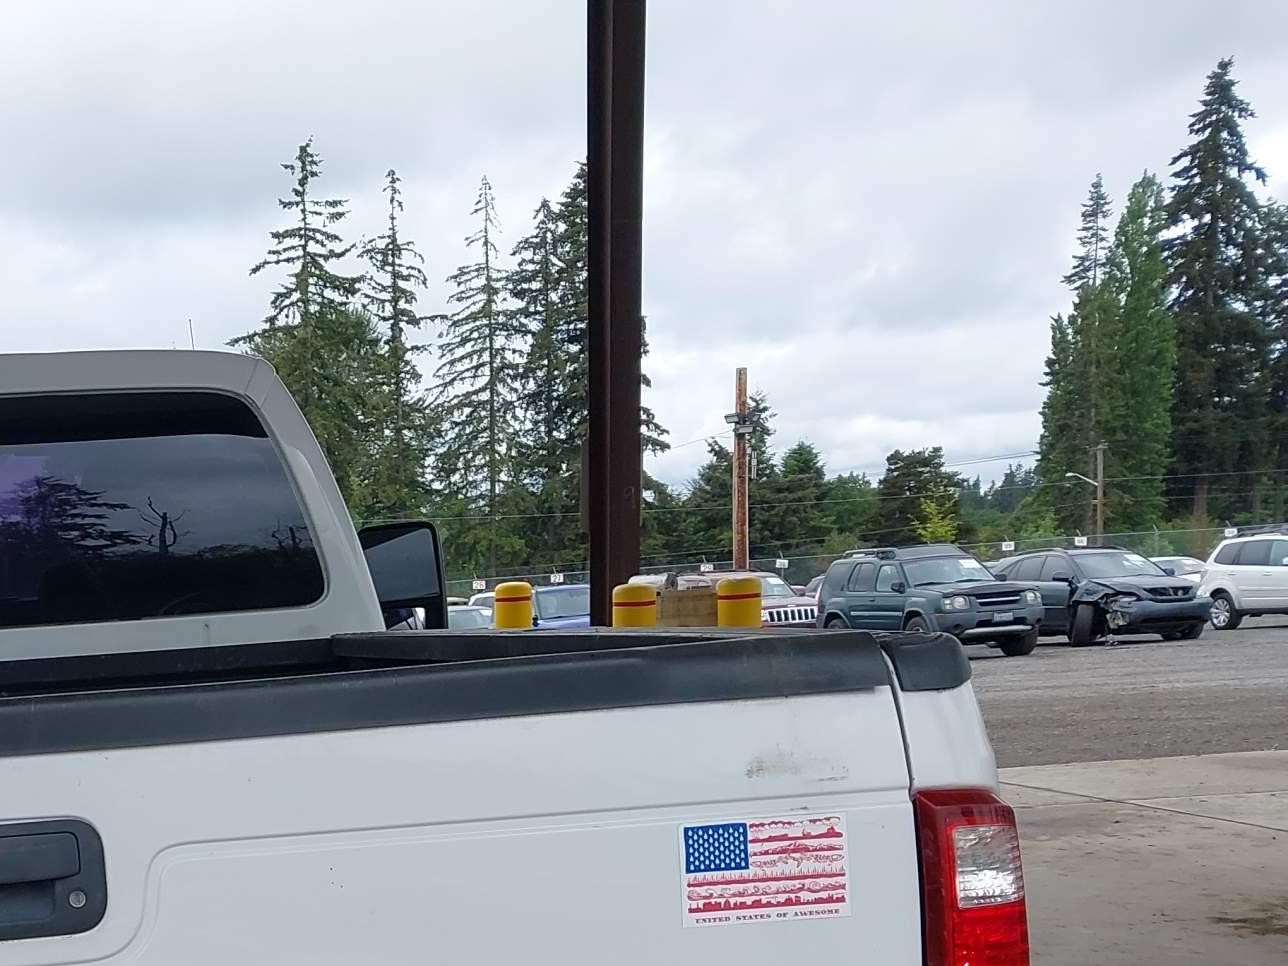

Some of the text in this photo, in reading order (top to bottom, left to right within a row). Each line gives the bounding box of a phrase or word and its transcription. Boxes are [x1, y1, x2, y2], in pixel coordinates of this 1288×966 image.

[695, 908, 841, 925] UNITED STATES OF AWESOME
